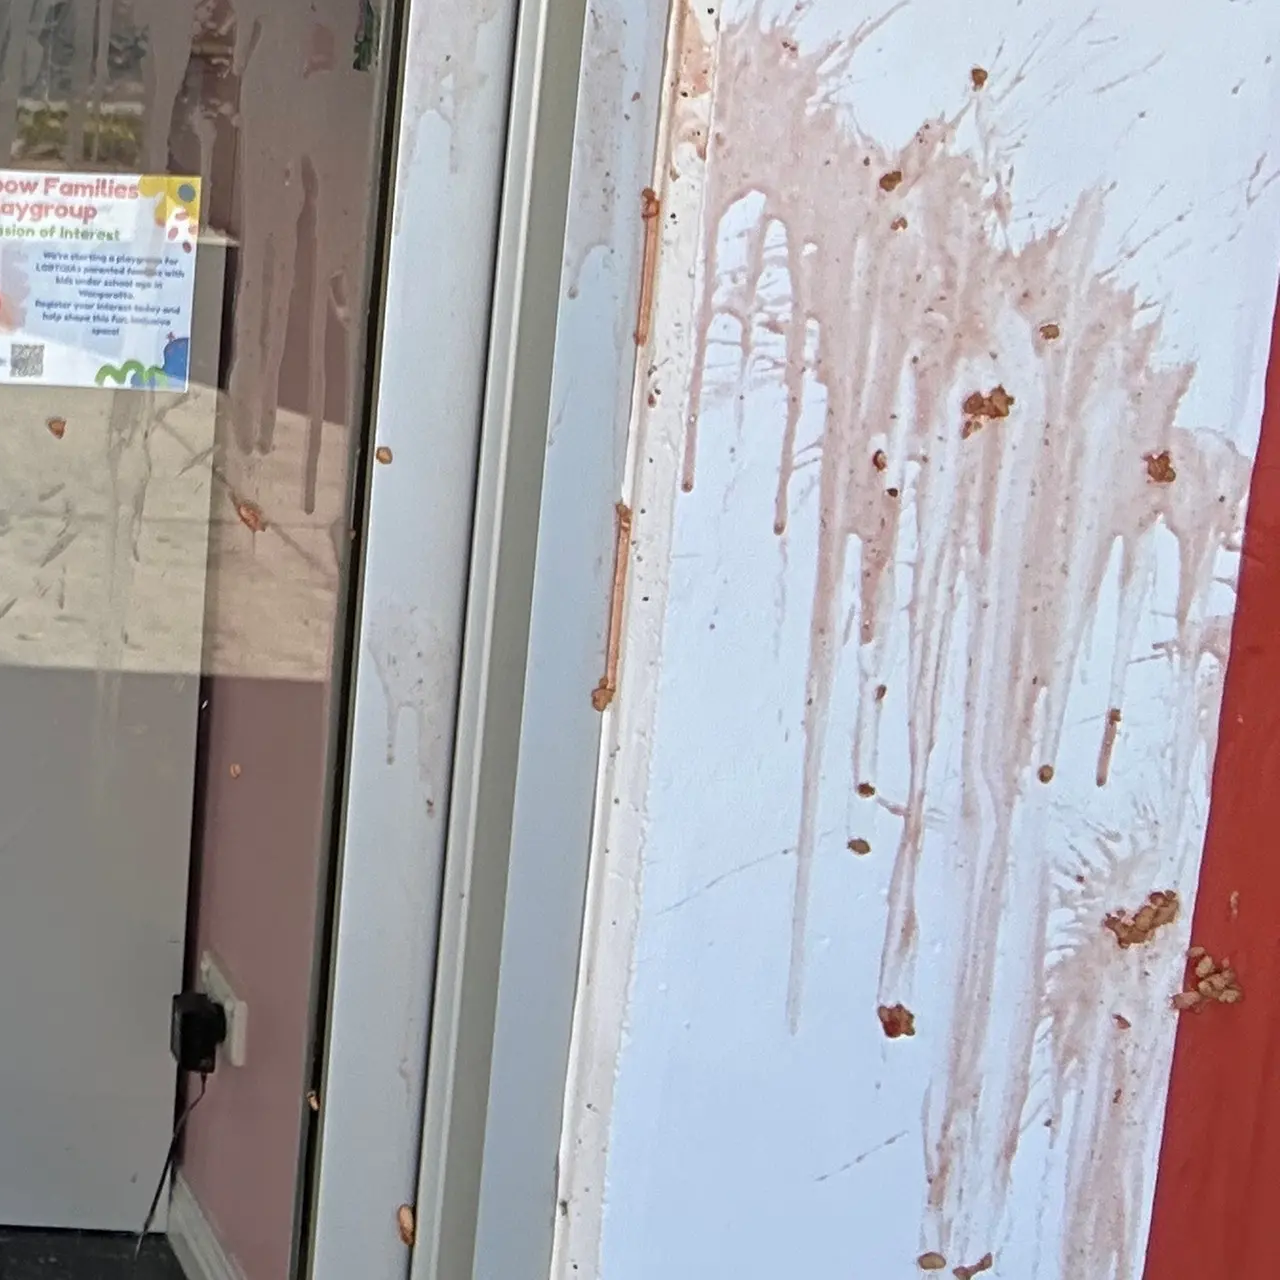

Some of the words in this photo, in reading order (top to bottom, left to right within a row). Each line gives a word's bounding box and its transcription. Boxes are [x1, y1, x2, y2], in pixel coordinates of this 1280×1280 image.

[43, 177, 141, 199] Families
[39, 224, 56, 238] of
[60, 225, 121, 241] Interest
